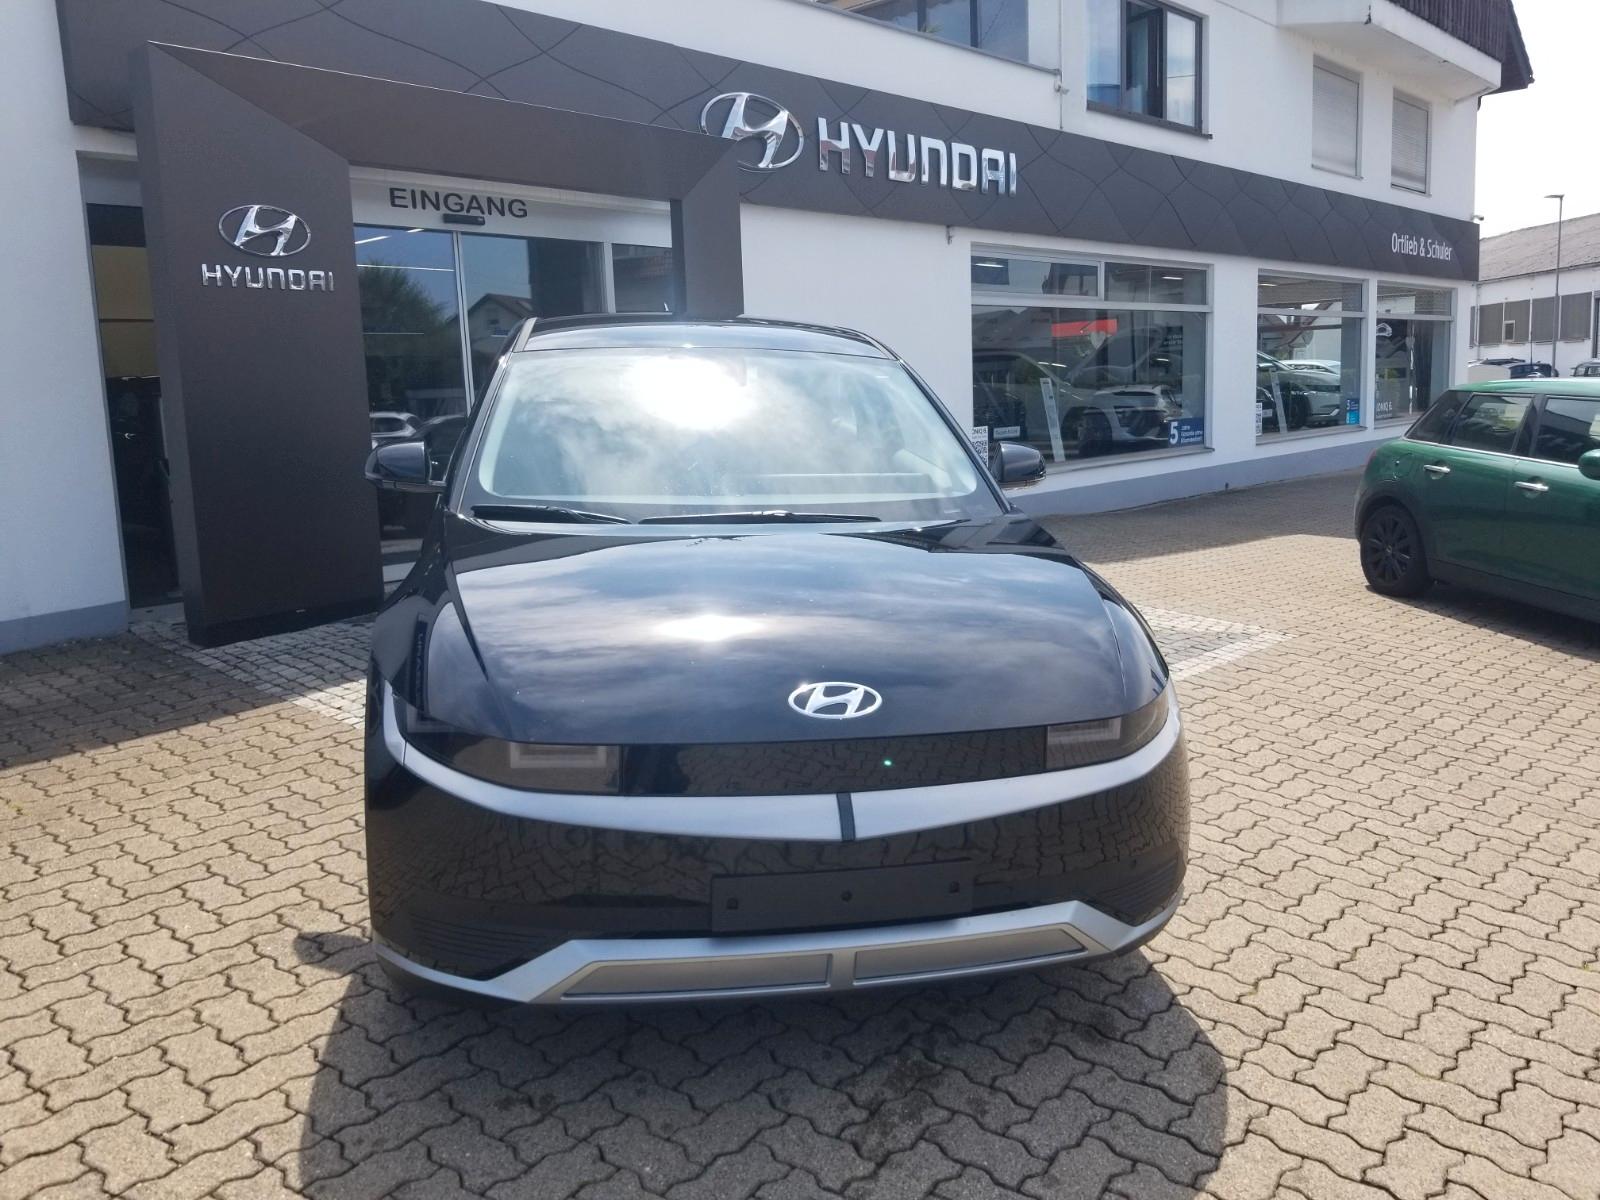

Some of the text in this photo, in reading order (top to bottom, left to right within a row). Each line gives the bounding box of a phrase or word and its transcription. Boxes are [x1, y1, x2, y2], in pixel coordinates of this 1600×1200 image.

[817, 117, 1018, 197] HYUNDAI
[388, 187, 529, 218] EINGANG
[1391, 232, 1453, 261] Ortlieb & Schuler
[201, 262, 335, 292] HYUNDAI
[1169, 421, 1179, 445] 5
